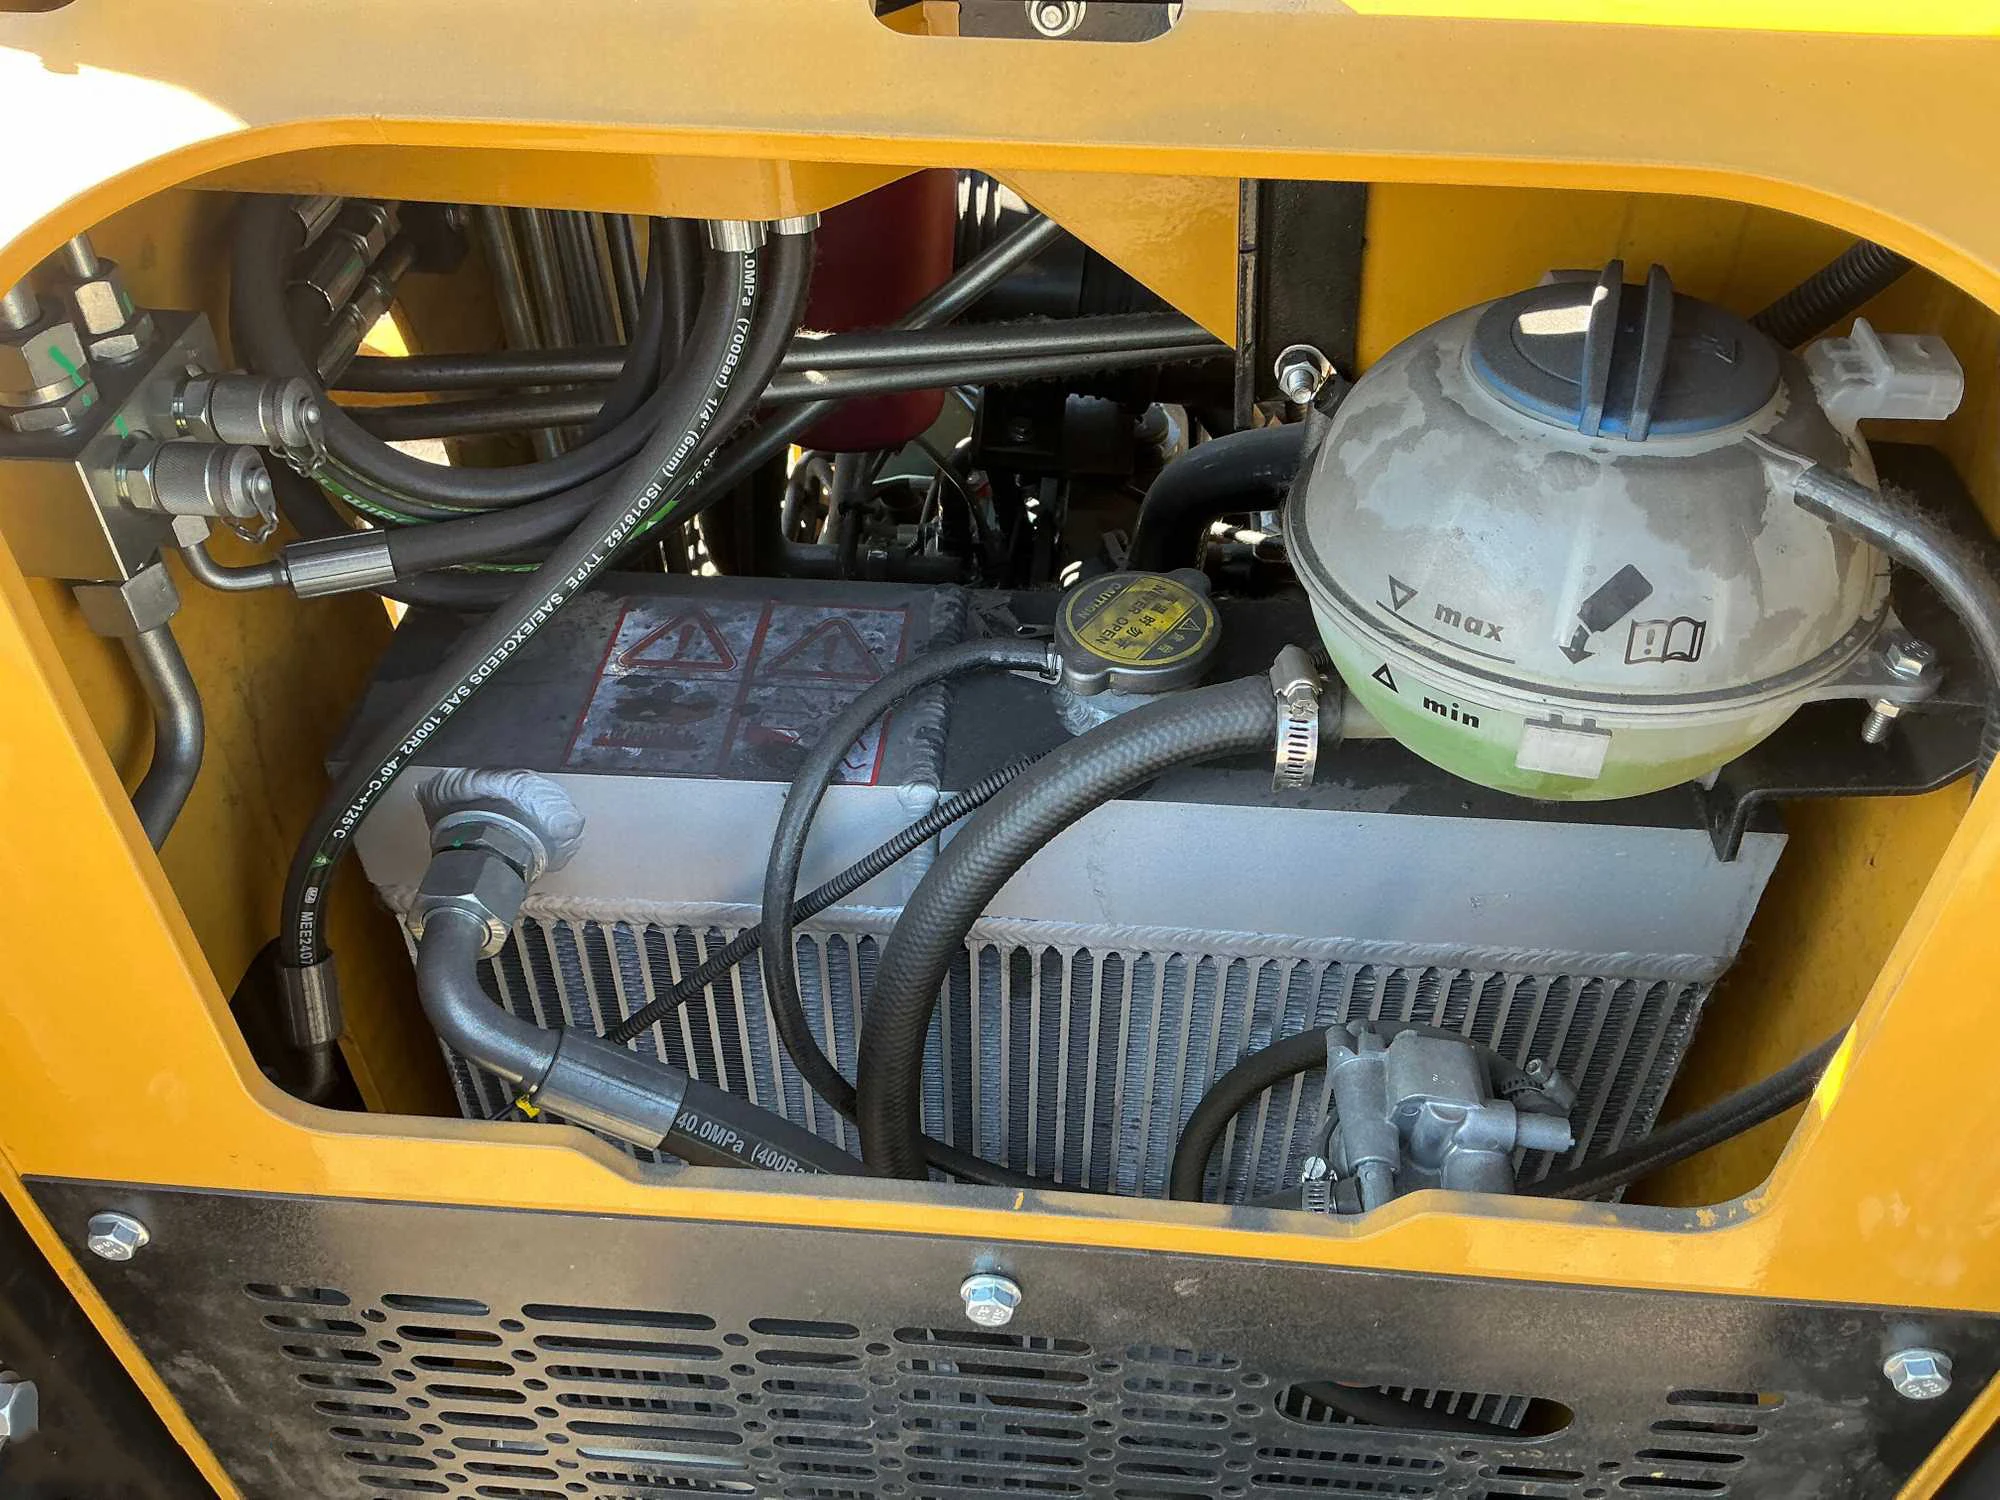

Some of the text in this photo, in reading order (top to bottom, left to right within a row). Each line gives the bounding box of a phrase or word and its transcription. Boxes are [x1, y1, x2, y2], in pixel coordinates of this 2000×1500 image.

[715, 317, 750, 389] (700Bar)
[700, 398, 718, 429] 1/4"
[662, 430, 700, 478] (6mm)
[604, 482, 663, 548] ISO18752
[565, 552, 604, 590] TYPE
[469, 592, 564, 685] SAE/EXCEEDS
[1096, 617, 1129, 646] OPEN
[1434, 603, 1504, 642] max
[439, 685, 471, 715] SAE
[1423, 696, 1480, 728] min
[400, 716, 441, 755] 100R2
[675, 1111, 745, 1154] 40.0MPa
